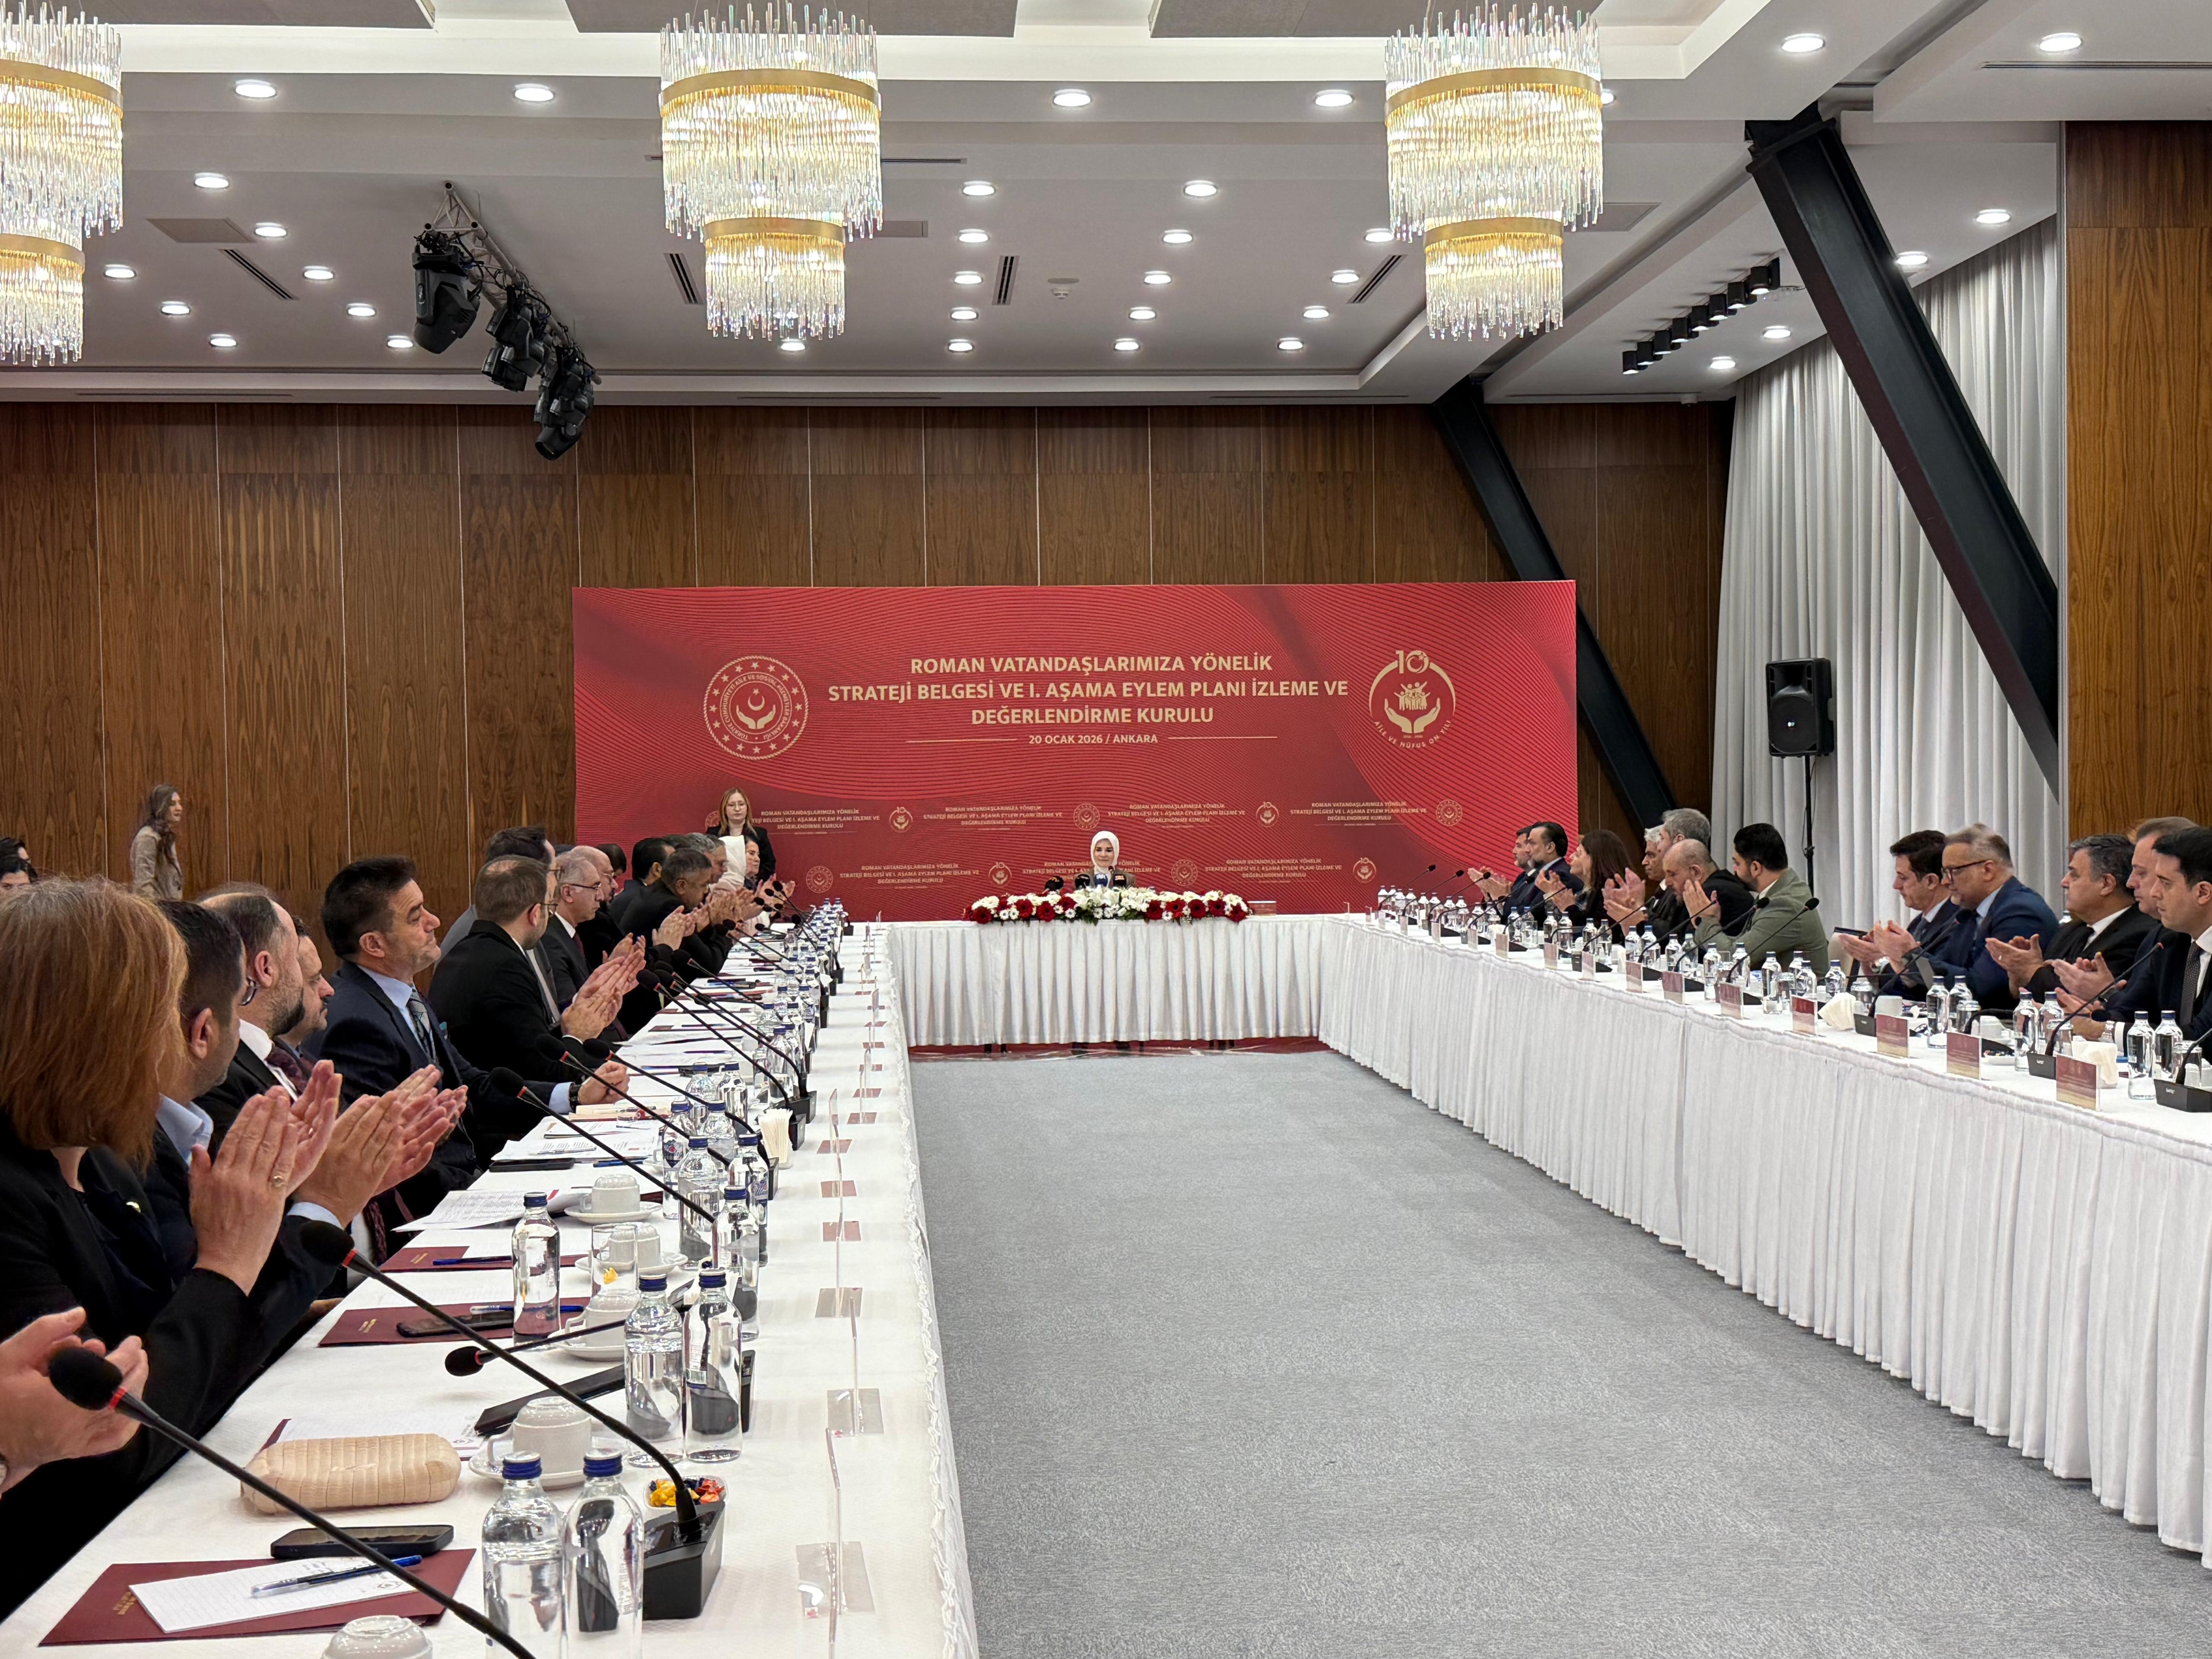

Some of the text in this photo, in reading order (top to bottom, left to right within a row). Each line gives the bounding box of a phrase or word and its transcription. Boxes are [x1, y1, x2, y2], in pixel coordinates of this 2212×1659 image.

[911, 652, 1273, 676] ROMAN VATANDAŞLARIMIZA YÖNELİK
[828, 677, 1348, 703] STRATEJİ BELGESİ VE I. AŞAMA EYLEM PLANI İZLEME VE
[972, 705, 1213, 725] DEĞERLENDİRME KURULU
[1029, 734, 1158, 744] 20 OCAK 2026 / ANKARA
[1388, 736, 1398, 744] VE
[1429, 734, 1440, 744] ON
